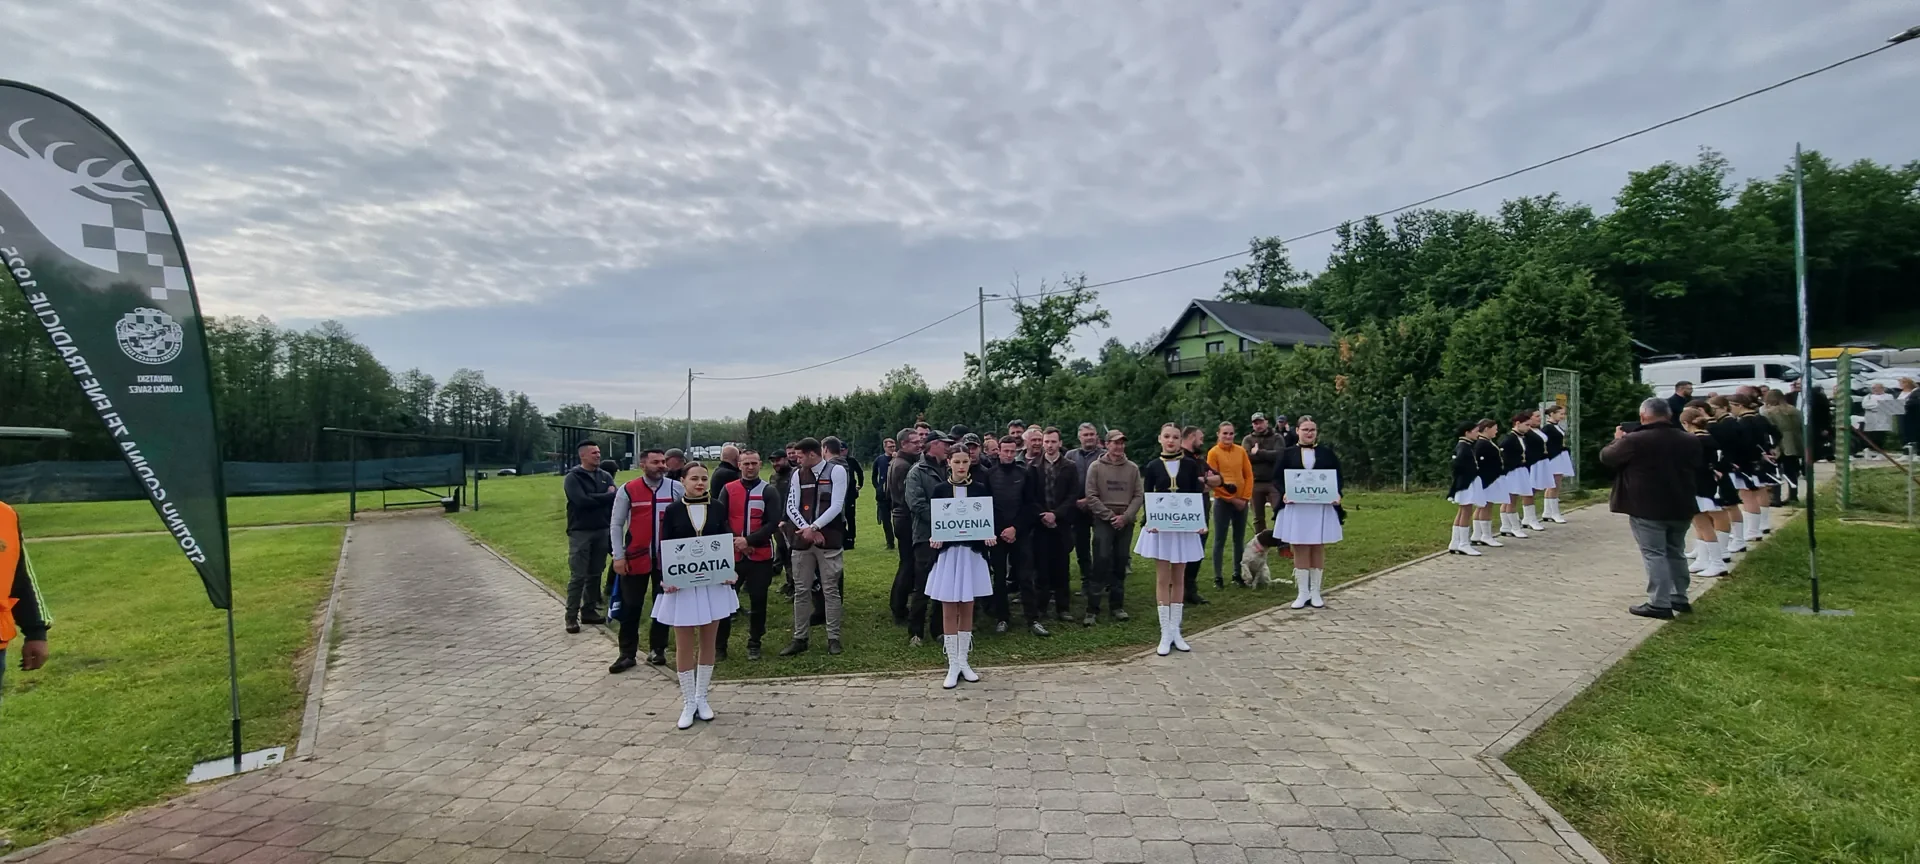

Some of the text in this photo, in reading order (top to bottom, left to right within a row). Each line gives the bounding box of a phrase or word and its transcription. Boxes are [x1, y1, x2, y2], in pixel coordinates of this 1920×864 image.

[1294, 486, 1328, 494] LATVIA
[1149, 512, 1201, 521] HUNGARY
[934, 518, 991, 530] SLOVENIA
[667, 558, 730, 576] CROATIA
